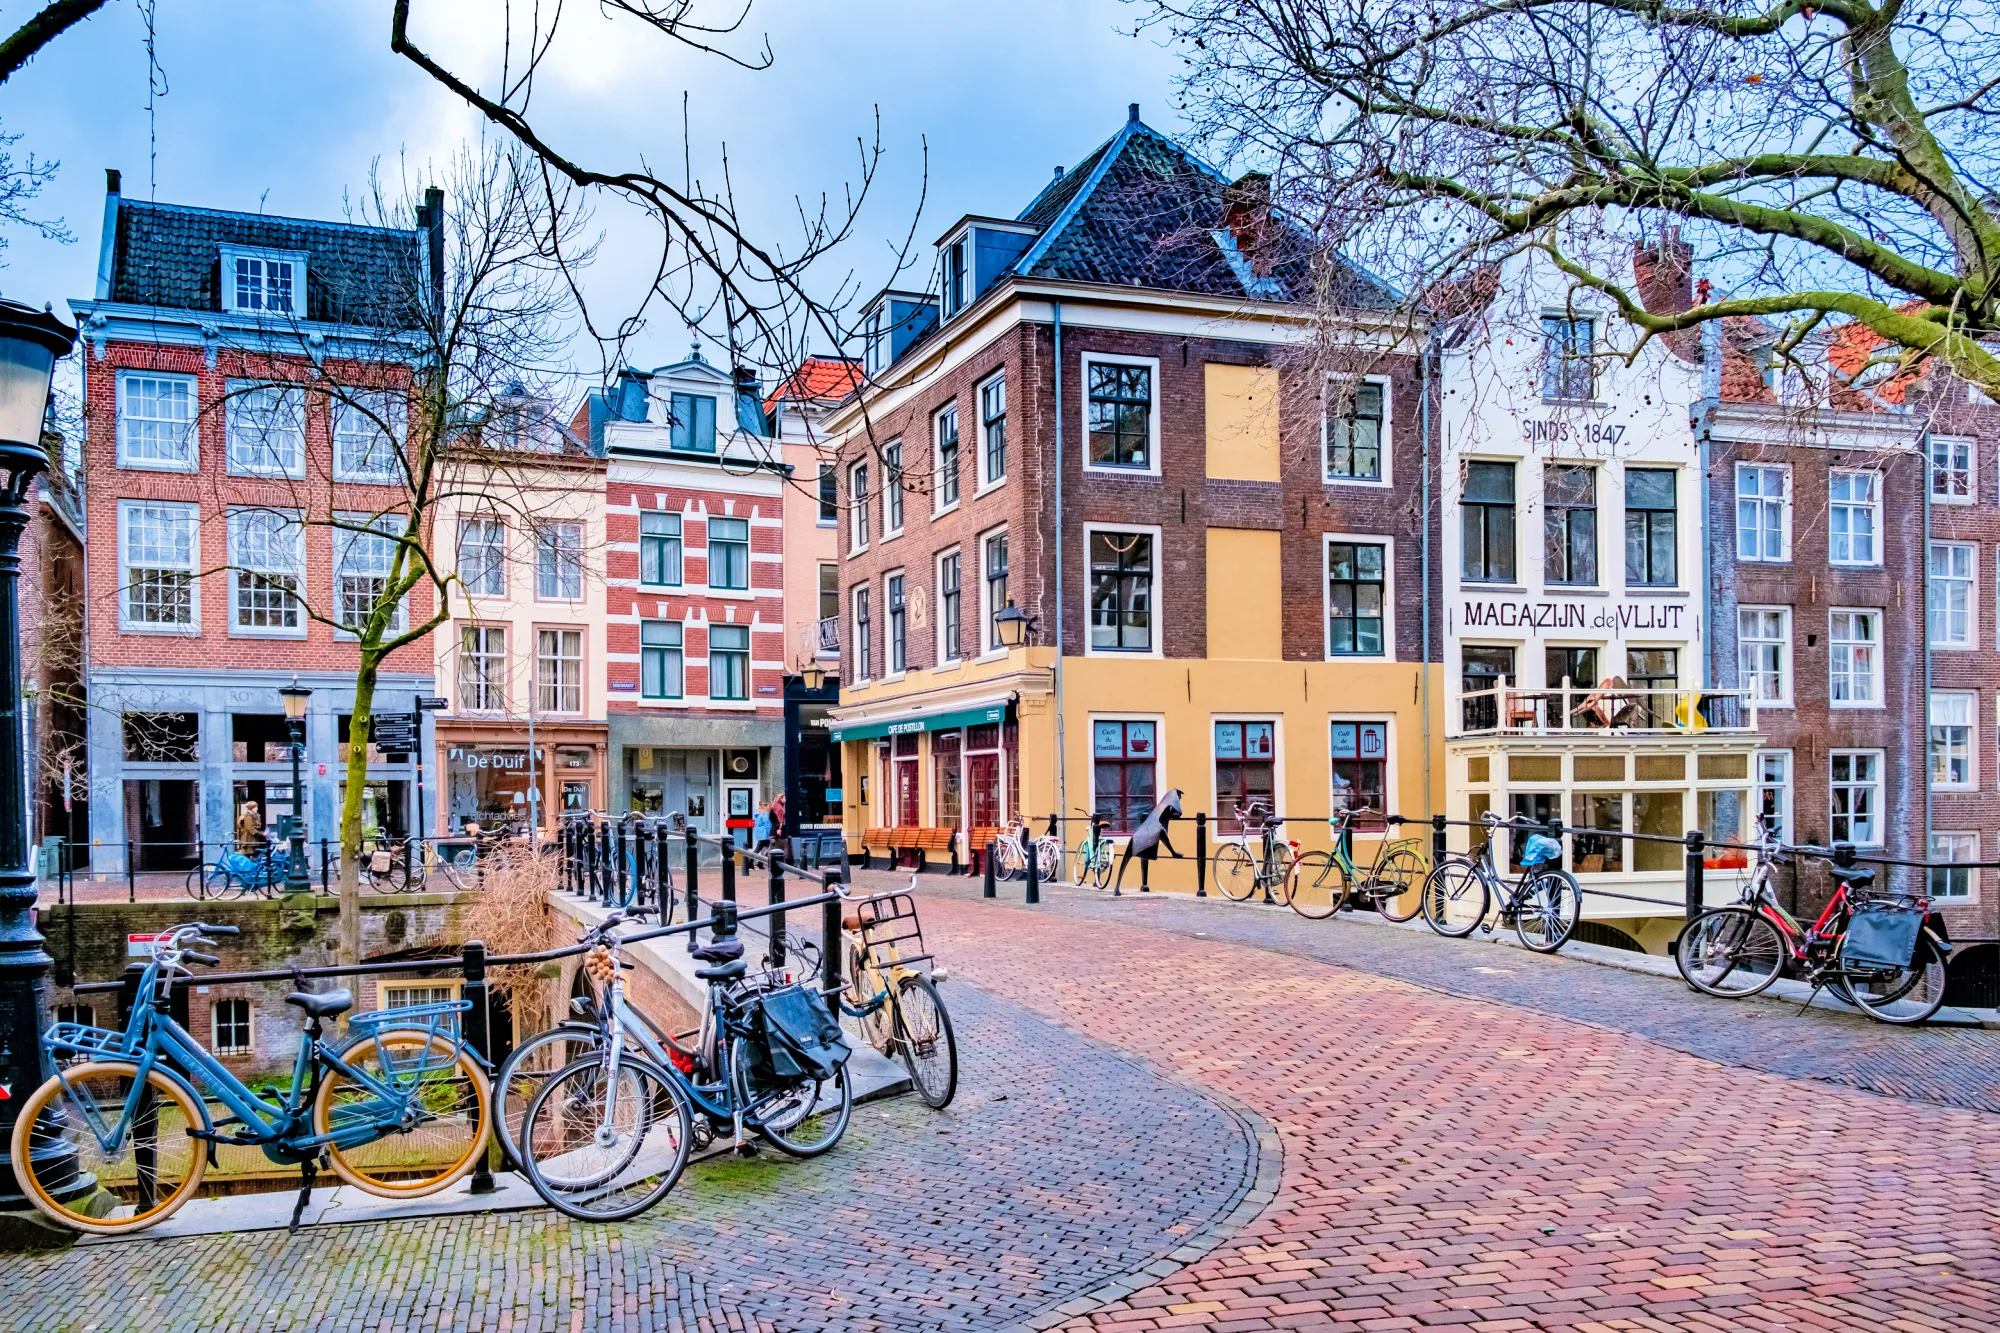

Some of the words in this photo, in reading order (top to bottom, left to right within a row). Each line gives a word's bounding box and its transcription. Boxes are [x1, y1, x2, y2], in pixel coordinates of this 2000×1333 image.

[1523, 420, 1569, 442] SINDS
[1464, 601, 1586, 628] MAGAZIJN
[898, 723, 904, 733] DE
[904, 721, 925, 733] POSTILLON
[467, 754, 488, 769] De
[493, 754, 526, 769] Duif
[573, 785, 586, 793] Duif
[180, 1054, 227, 1096] GAZELLE
